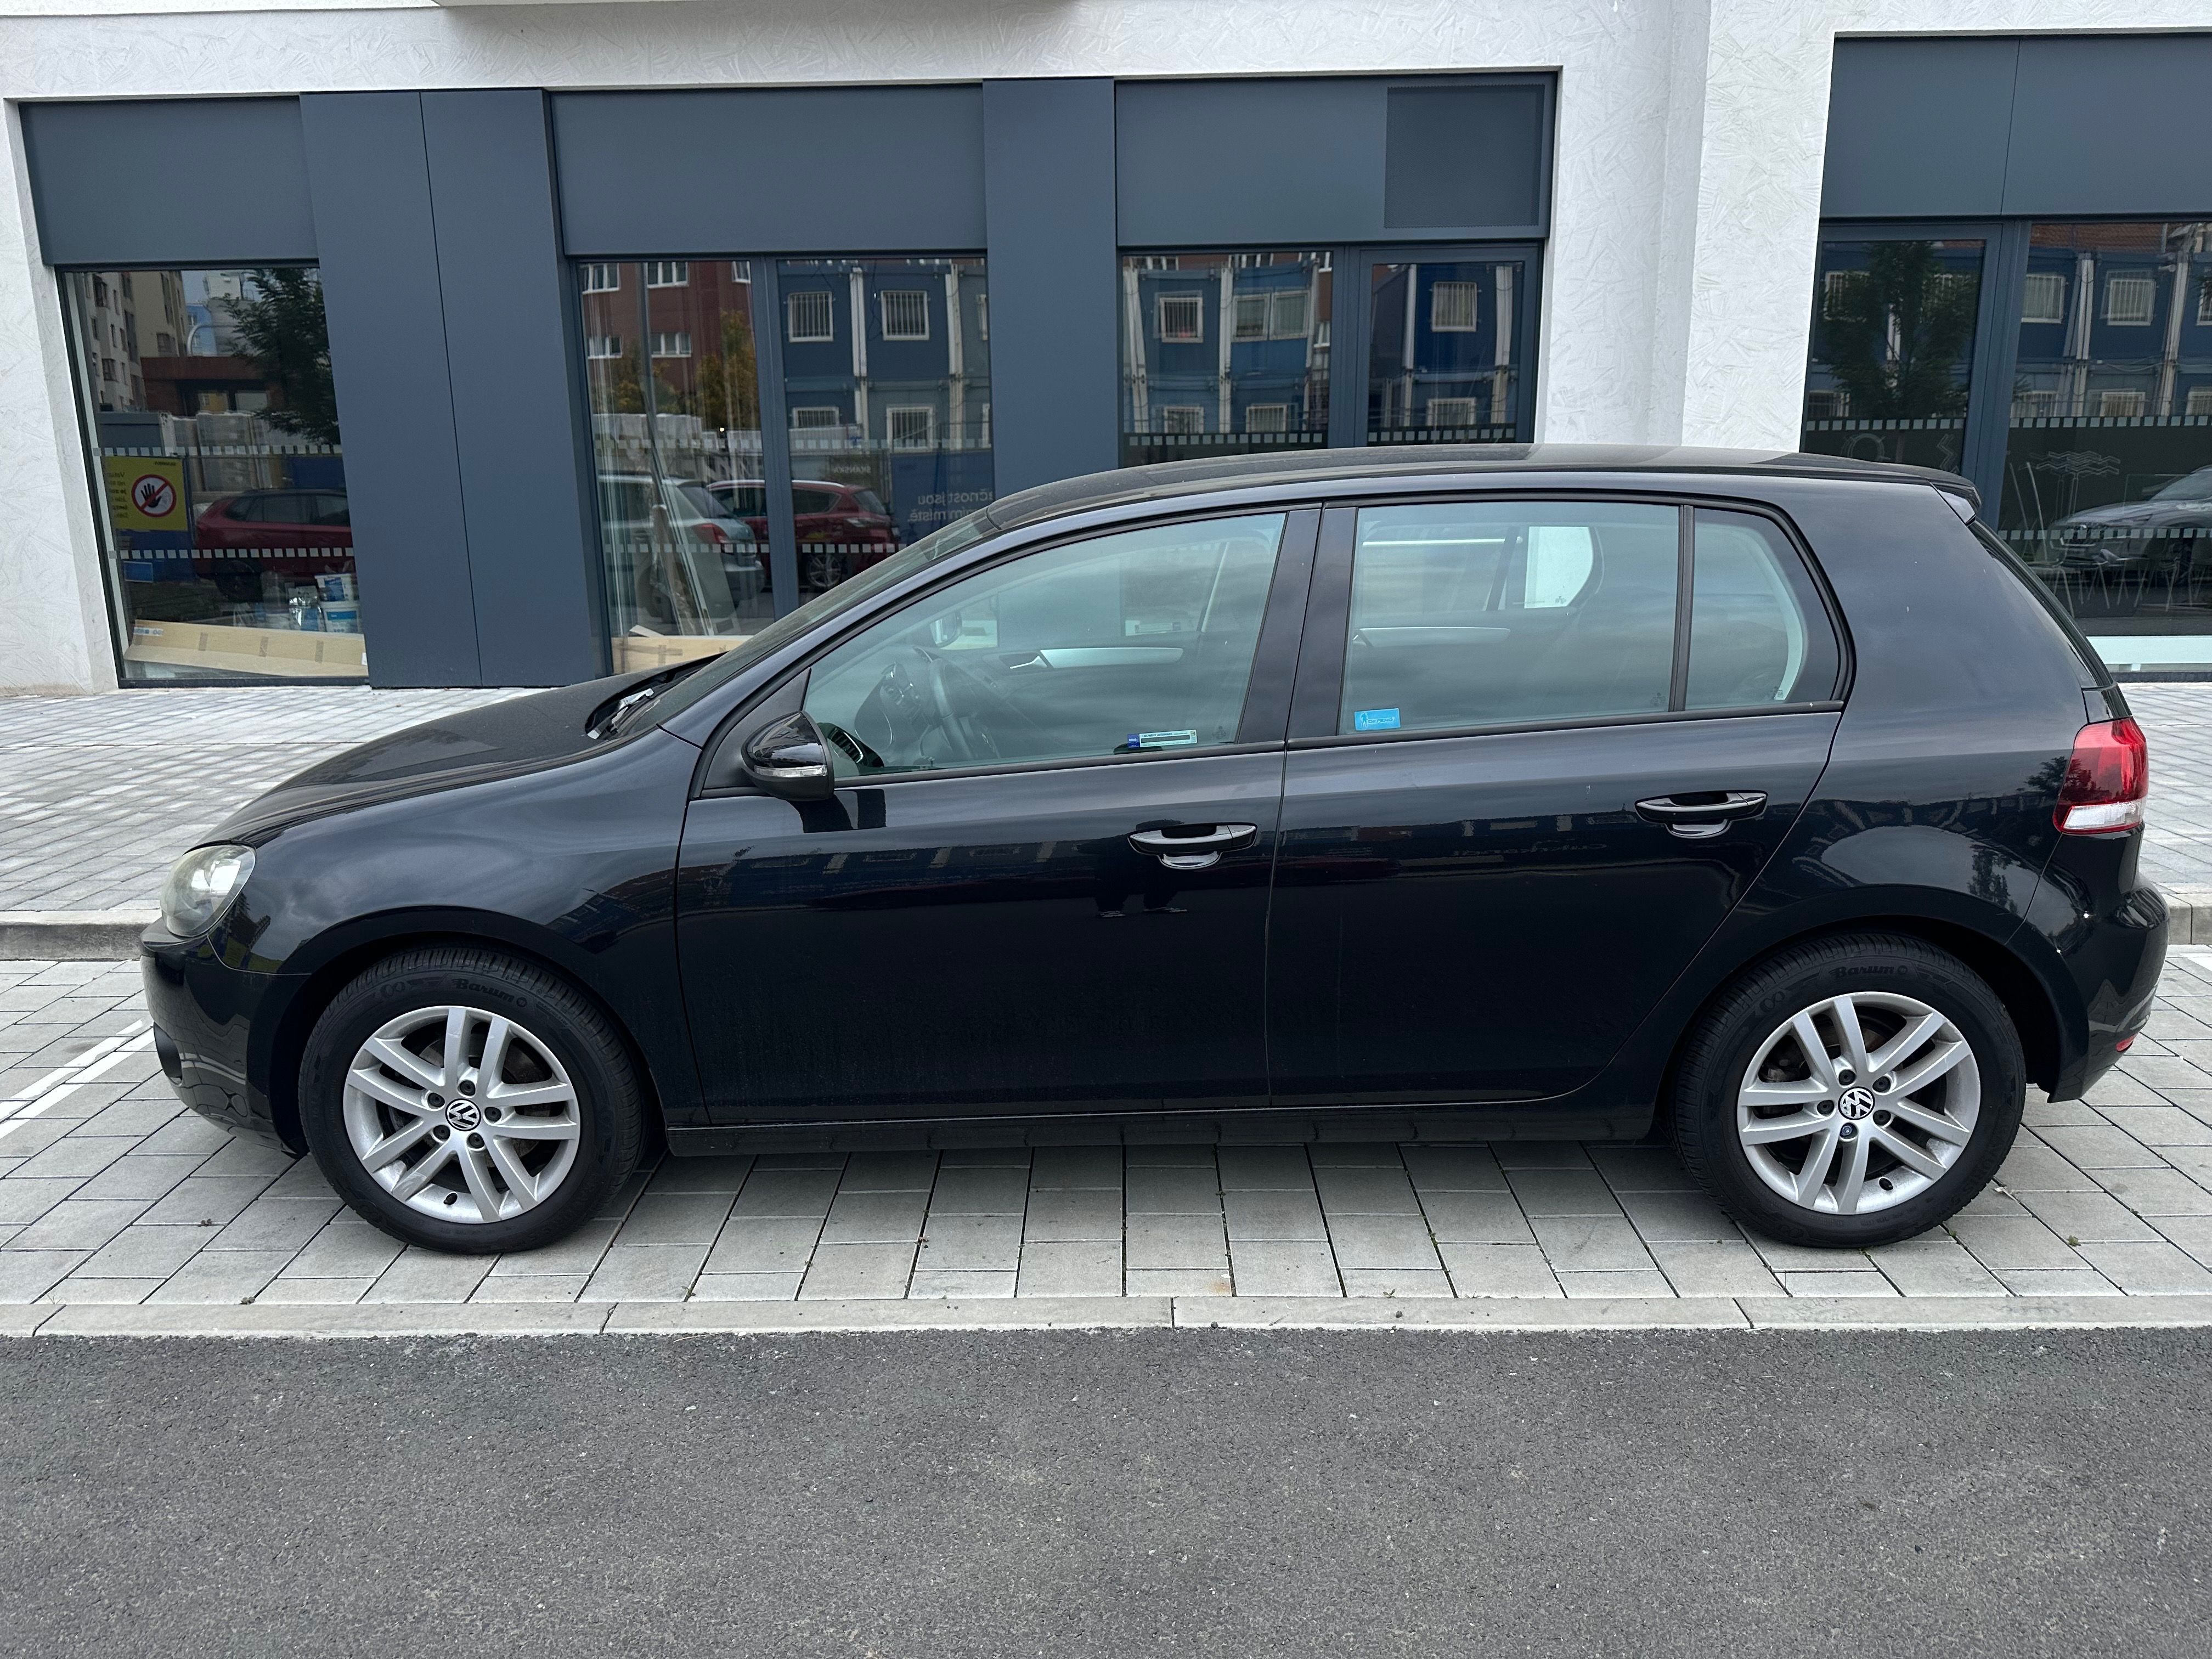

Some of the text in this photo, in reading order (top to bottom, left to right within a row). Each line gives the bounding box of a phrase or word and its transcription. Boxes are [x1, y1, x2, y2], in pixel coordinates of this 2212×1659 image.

[1829, 967, 1894, 978] Barum
[451, 978, 515, 1003] Barum
[448, 1101, 479, 1130] VW
